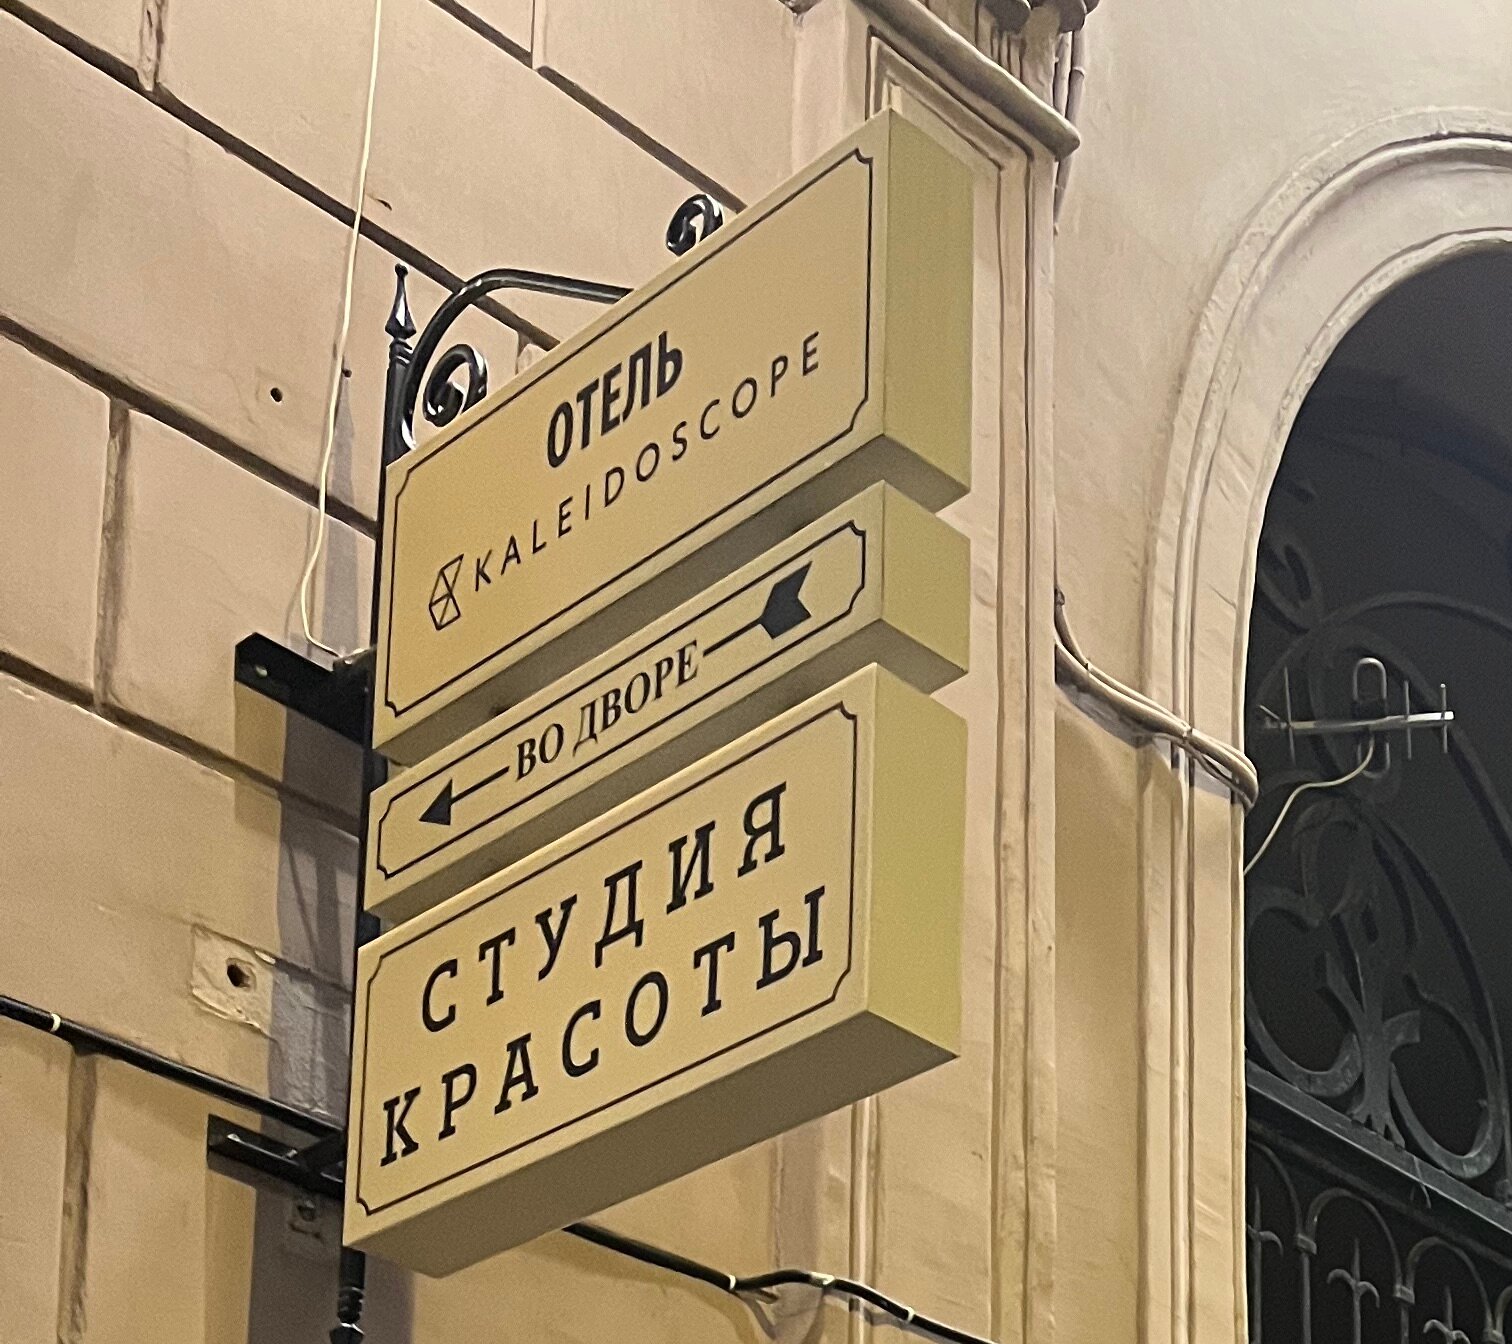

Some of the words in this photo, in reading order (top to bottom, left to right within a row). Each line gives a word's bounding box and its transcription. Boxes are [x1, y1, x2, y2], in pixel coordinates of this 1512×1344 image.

[471, 330, 822, 591] KALEIDOSCOPE
[546, 330, 685, 470] ОТЕЛЬ
[514, 722, 573, 783] ВО
[573, 637, 702, 751] ДВОРЕ
[379, 885, 827, 1168] КРАСОТЫ
[421, 781, 788, 1033] СТУДИЯ
